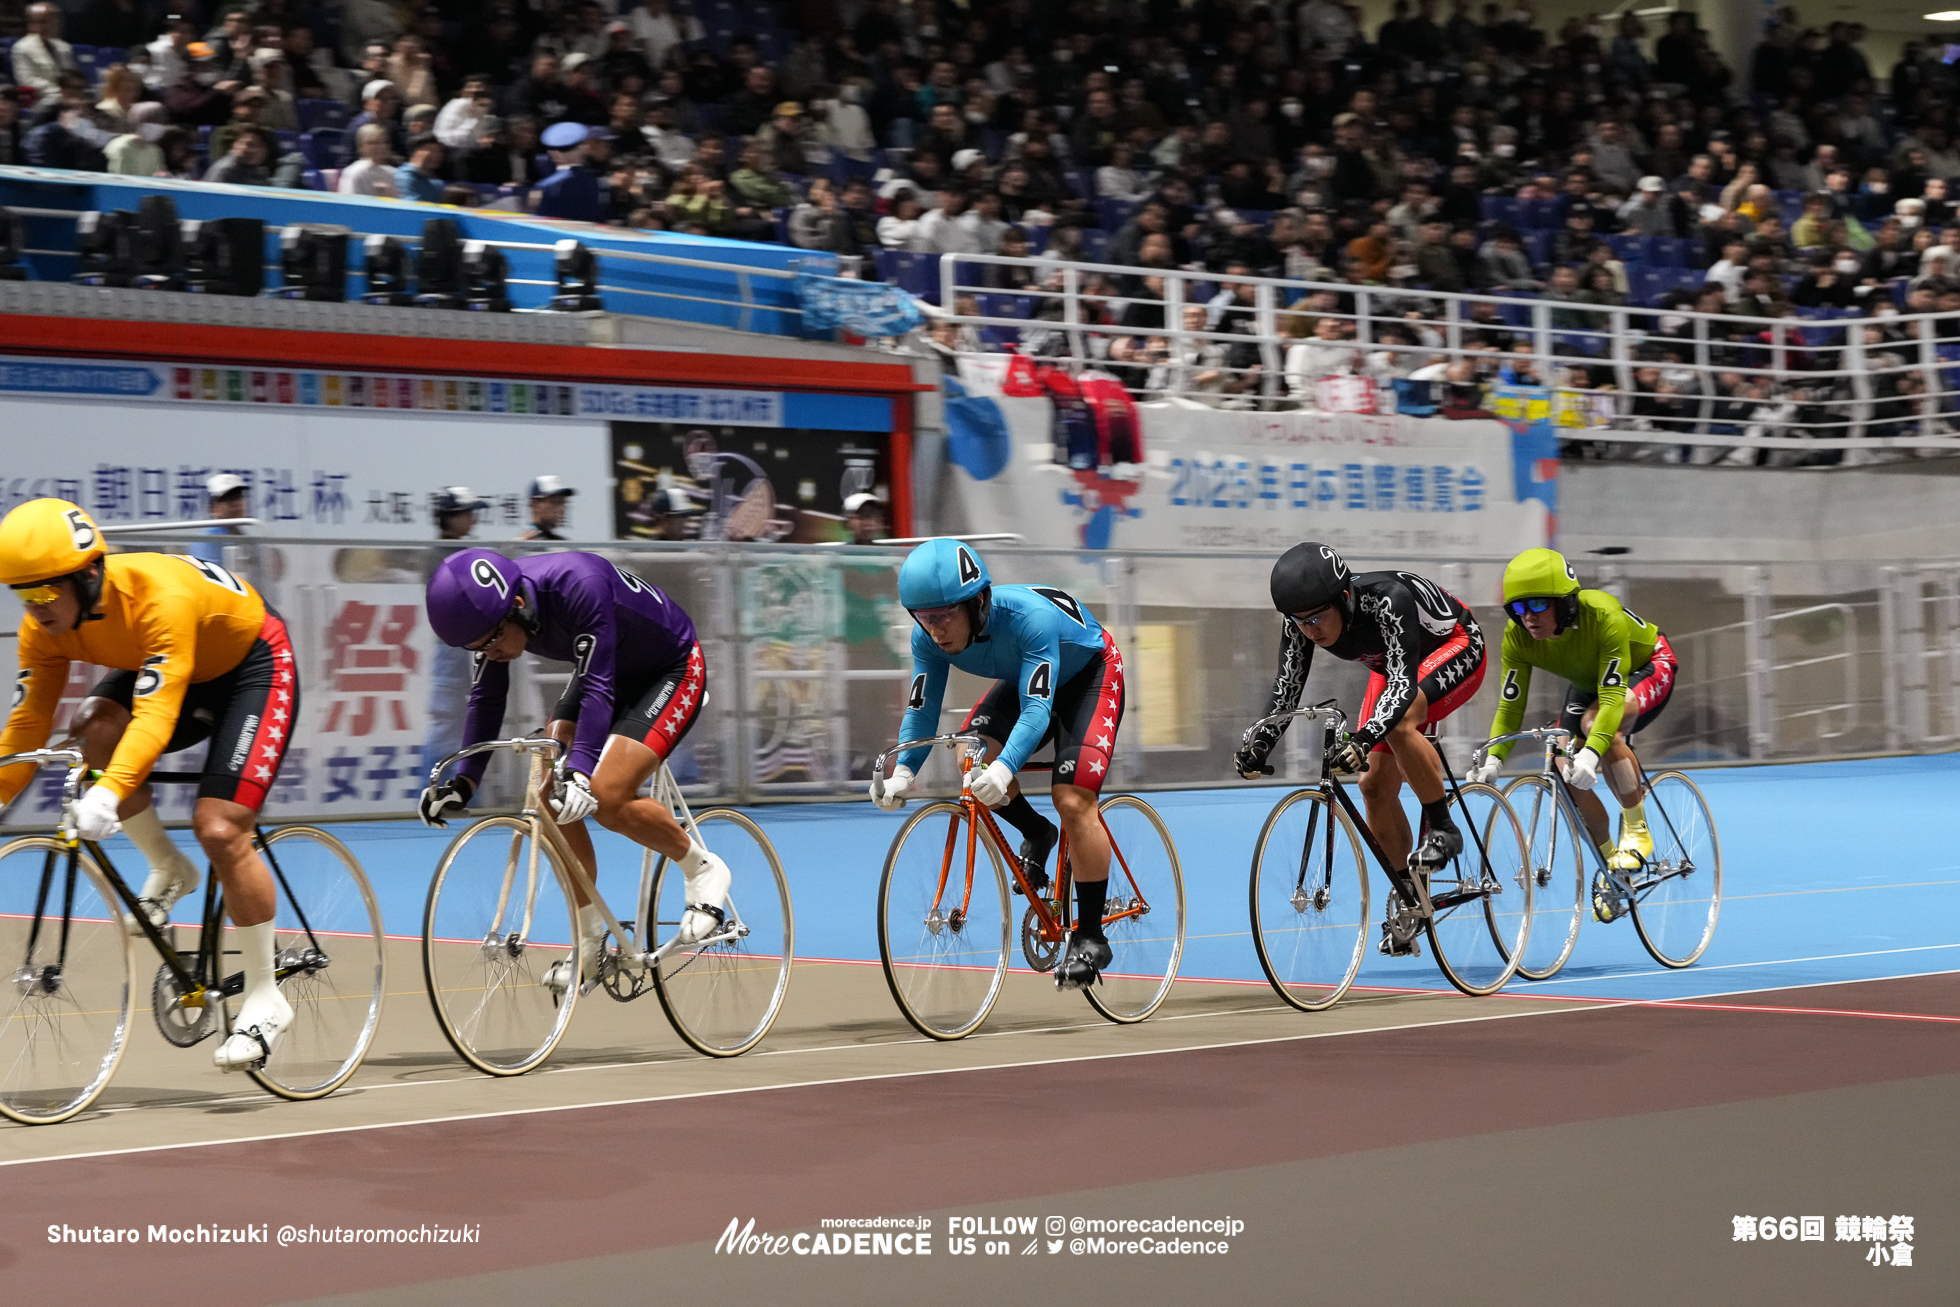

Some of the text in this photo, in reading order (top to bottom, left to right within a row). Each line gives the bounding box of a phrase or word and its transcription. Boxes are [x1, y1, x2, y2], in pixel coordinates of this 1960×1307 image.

[61, 508, 97, 551] 5
[471, 558, 509, 600] 9
[957, 546, 981, 587] 4
[1319, 546, 1348, 580] 2
[1026, 586, 1087, 630] 4
[1396, 572, 1453, 617] 2
[132, 654, 168, 698] 5
[573, 633, 597, 677] 9
[1601, 657, 1623, 688] 6
[12, 667, 33, 709] 5
[907, 673, 928, 710] 4
[1027, 662, 1051, 701] 4
[1501, 669, 1520, 702] 6
